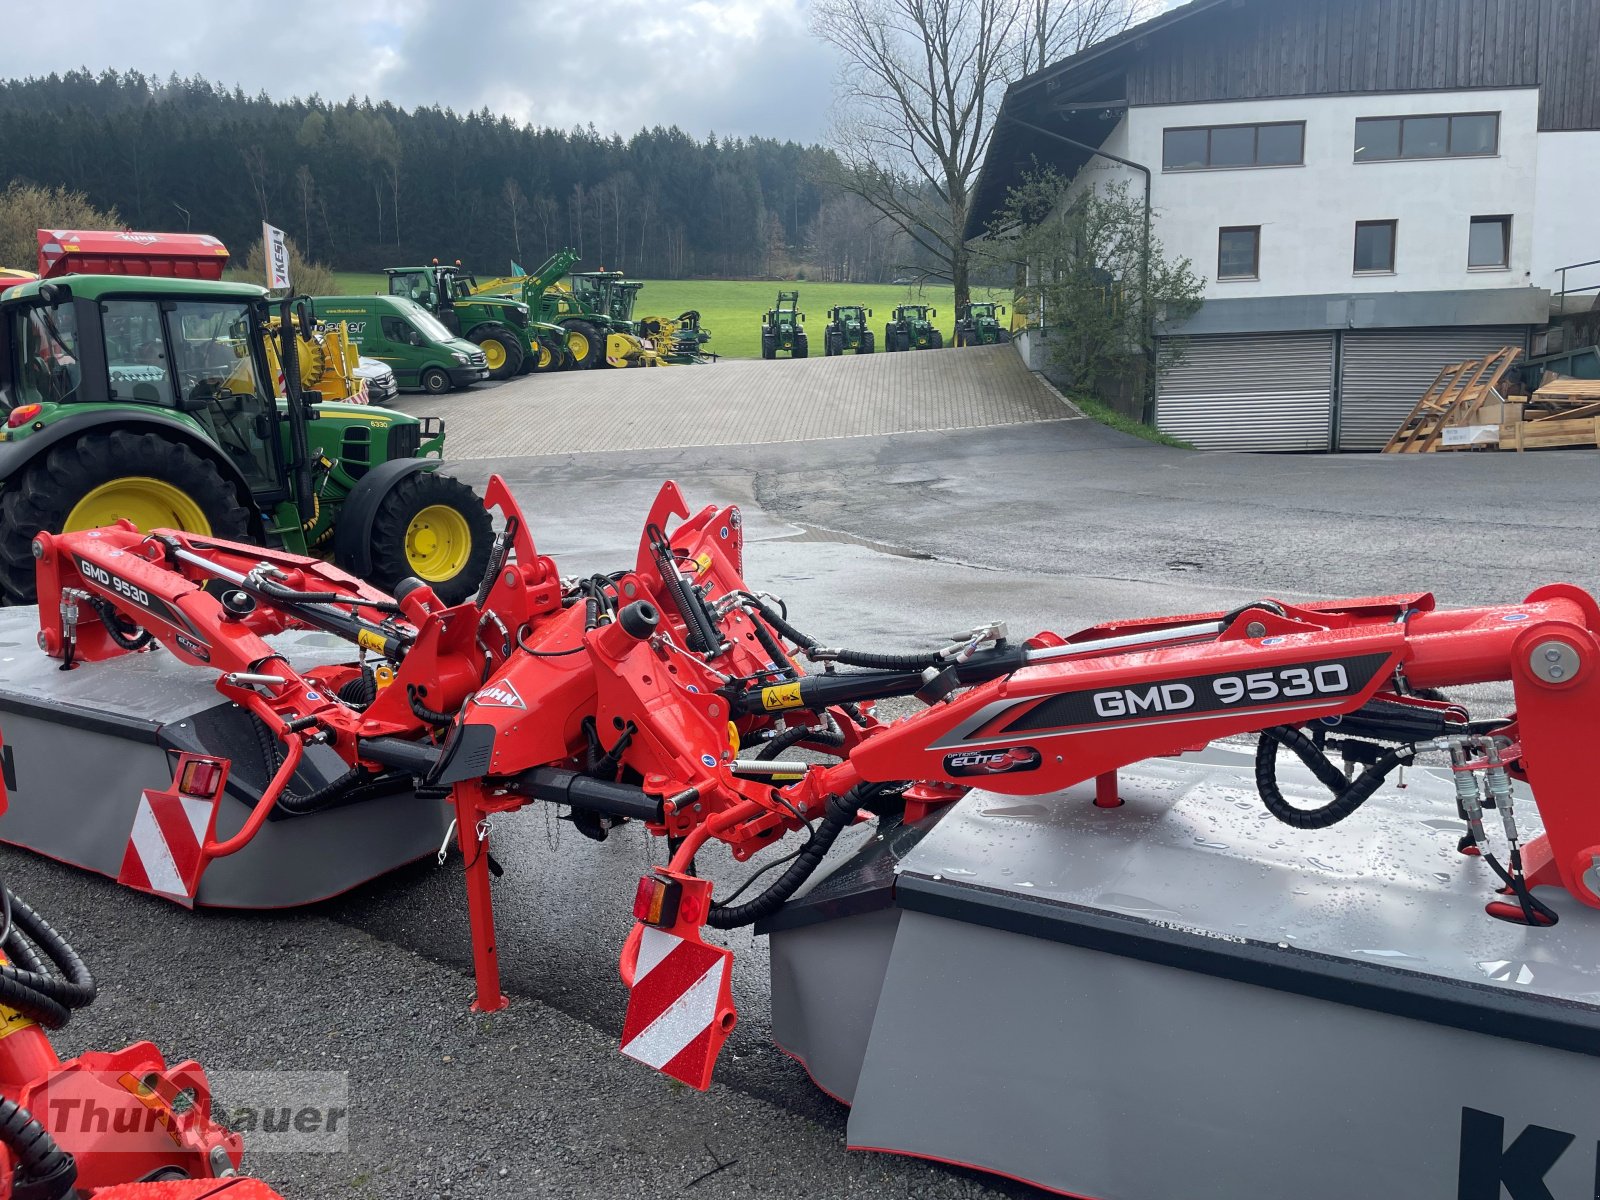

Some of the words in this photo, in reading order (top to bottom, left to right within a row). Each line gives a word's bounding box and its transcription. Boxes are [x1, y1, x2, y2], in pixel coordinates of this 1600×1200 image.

[81, 560, 110, 585] GMD
[113, 576, 149, 606] 9530
[1093, 683, 1195, 717] GMD
[1212, 663, 1349, 704] 9530
[951, 753, 1004, 767] ELITE
